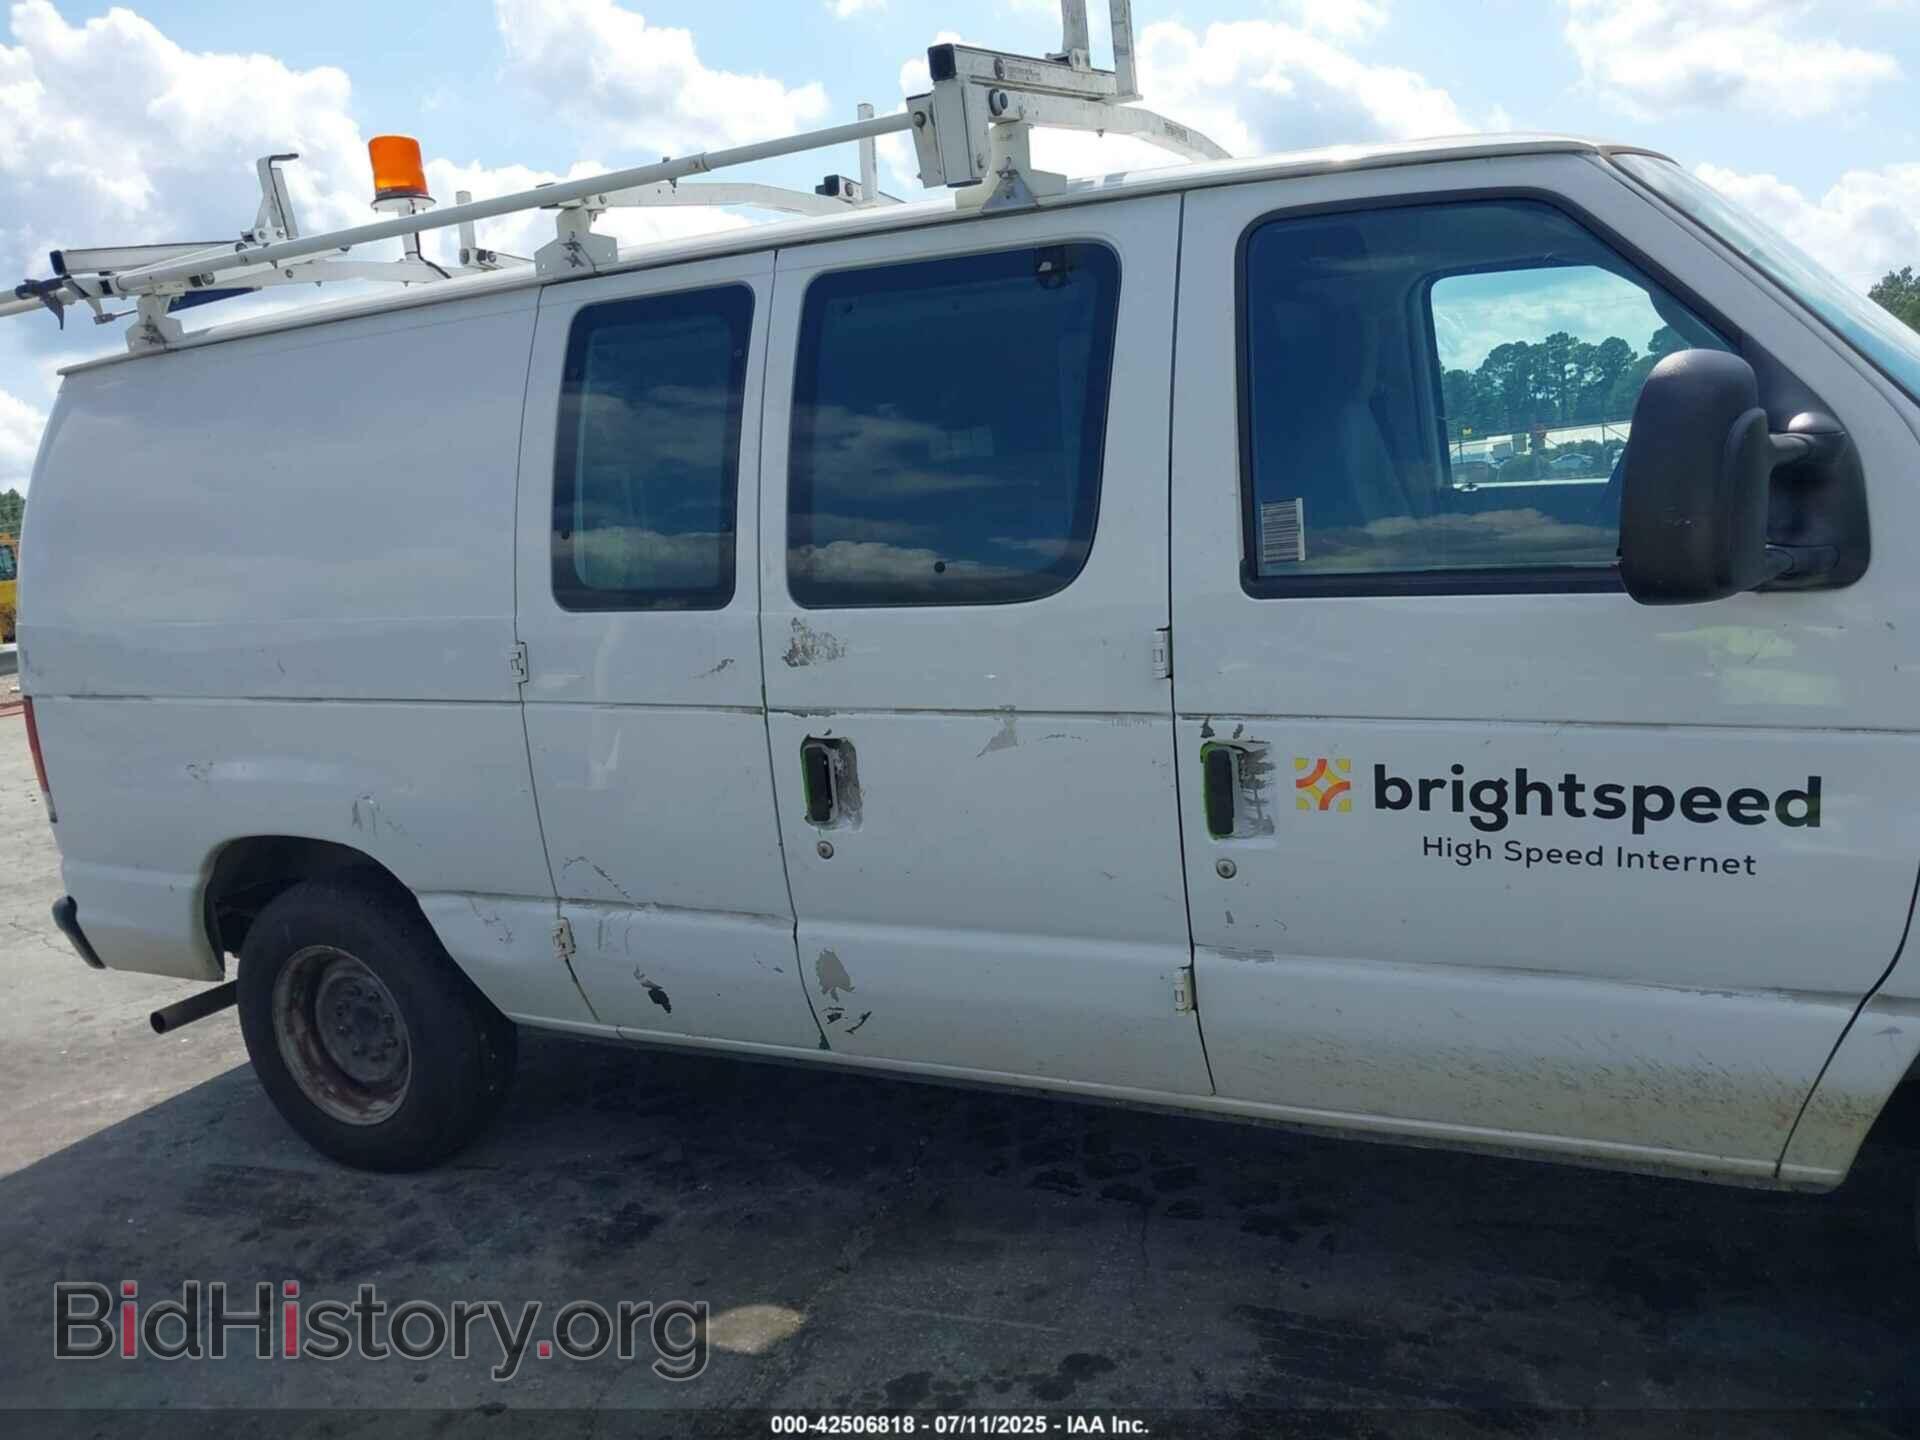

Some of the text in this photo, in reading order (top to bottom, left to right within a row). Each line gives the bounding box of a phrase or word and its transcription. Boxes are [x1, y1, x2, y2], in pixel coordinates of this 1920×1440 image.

[1374, 764, 1822, 834] brightspeed
[1423, 836, 1757, 875] High Speed Internet
